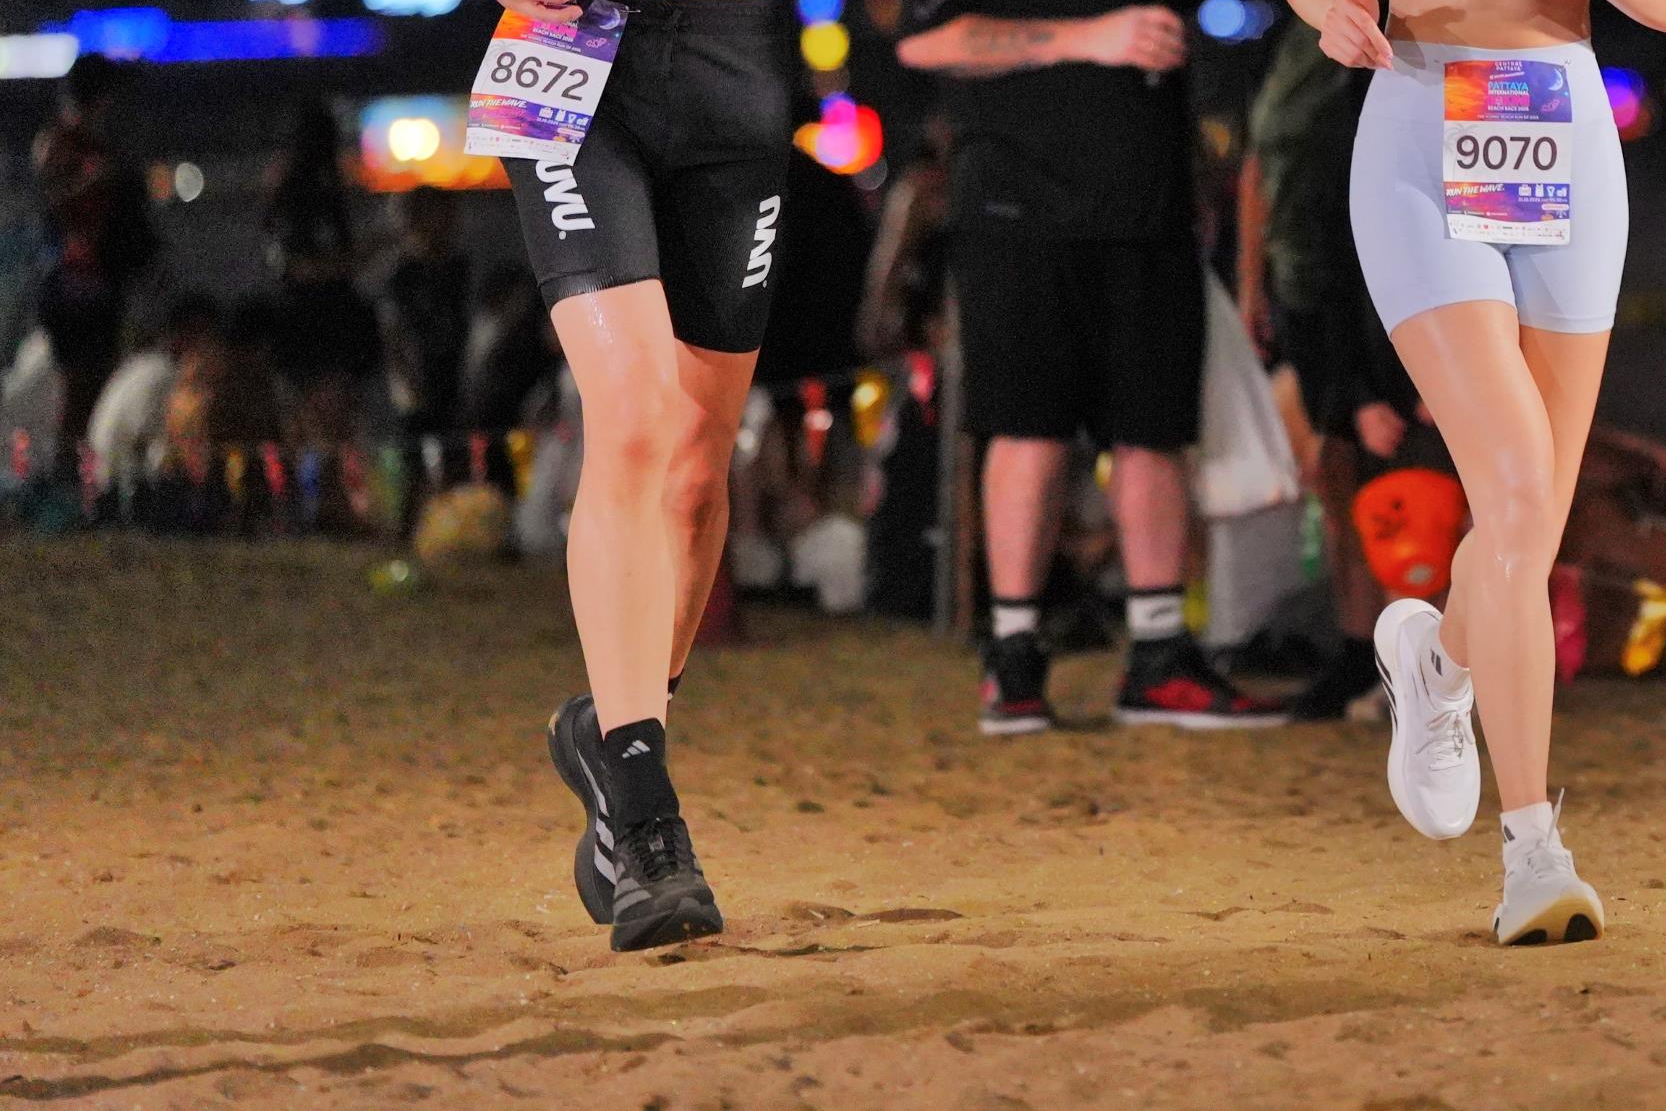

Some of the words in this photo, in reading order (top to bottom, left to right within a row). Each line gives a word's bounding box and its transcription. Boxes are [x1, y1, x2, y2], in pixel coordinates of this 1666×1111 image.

[490, 52, 589, 101] 8672
[1488, 81, 1529, 90] PATTAYA
[1456, 135, 1557, 171] 9070
[1446, 187, 1462, 197] RUN
[1462, 185, 1479, 195] THE
